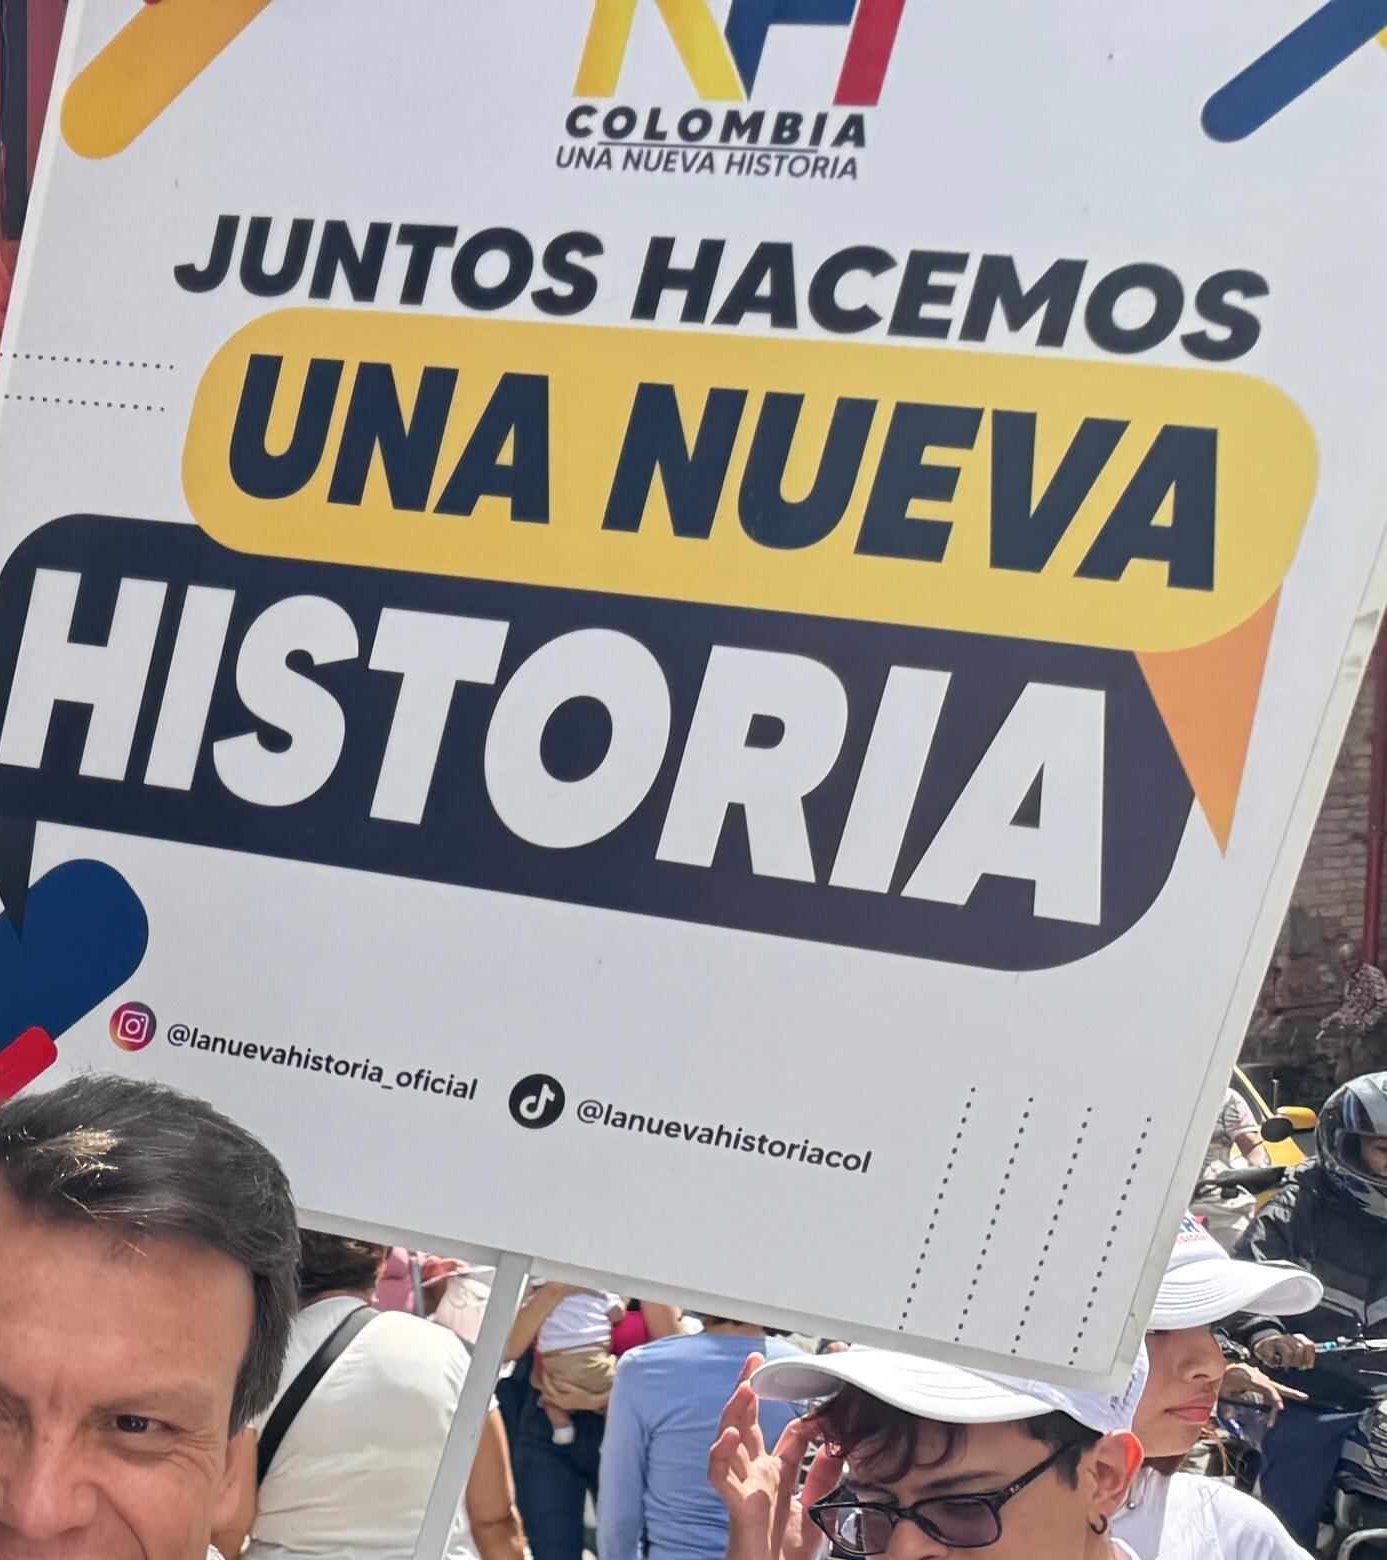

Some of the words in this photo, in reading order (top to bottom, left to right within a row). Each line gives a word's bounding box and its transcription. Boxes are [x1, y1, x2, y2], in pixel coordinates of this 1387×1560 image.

[555, 146, 613, 170] UNA
[622, 148, 716, 175] NUEVA
[725, 152, 859, 181] HISTORIA
[564, 104, 866, 148] COLOMBIA
[174, 214, 605, 314] JUNTOS
[628, 238, 1270, 362] HACEMOS
[227, 353, 551, 526] UNA
[602, 380, 1219, 592] NUEVA
[166, 1022, 478, 1102] @lanuevahistoria_oficial
[575, 1097, 873, 1175] @lanuevahistoriacol
